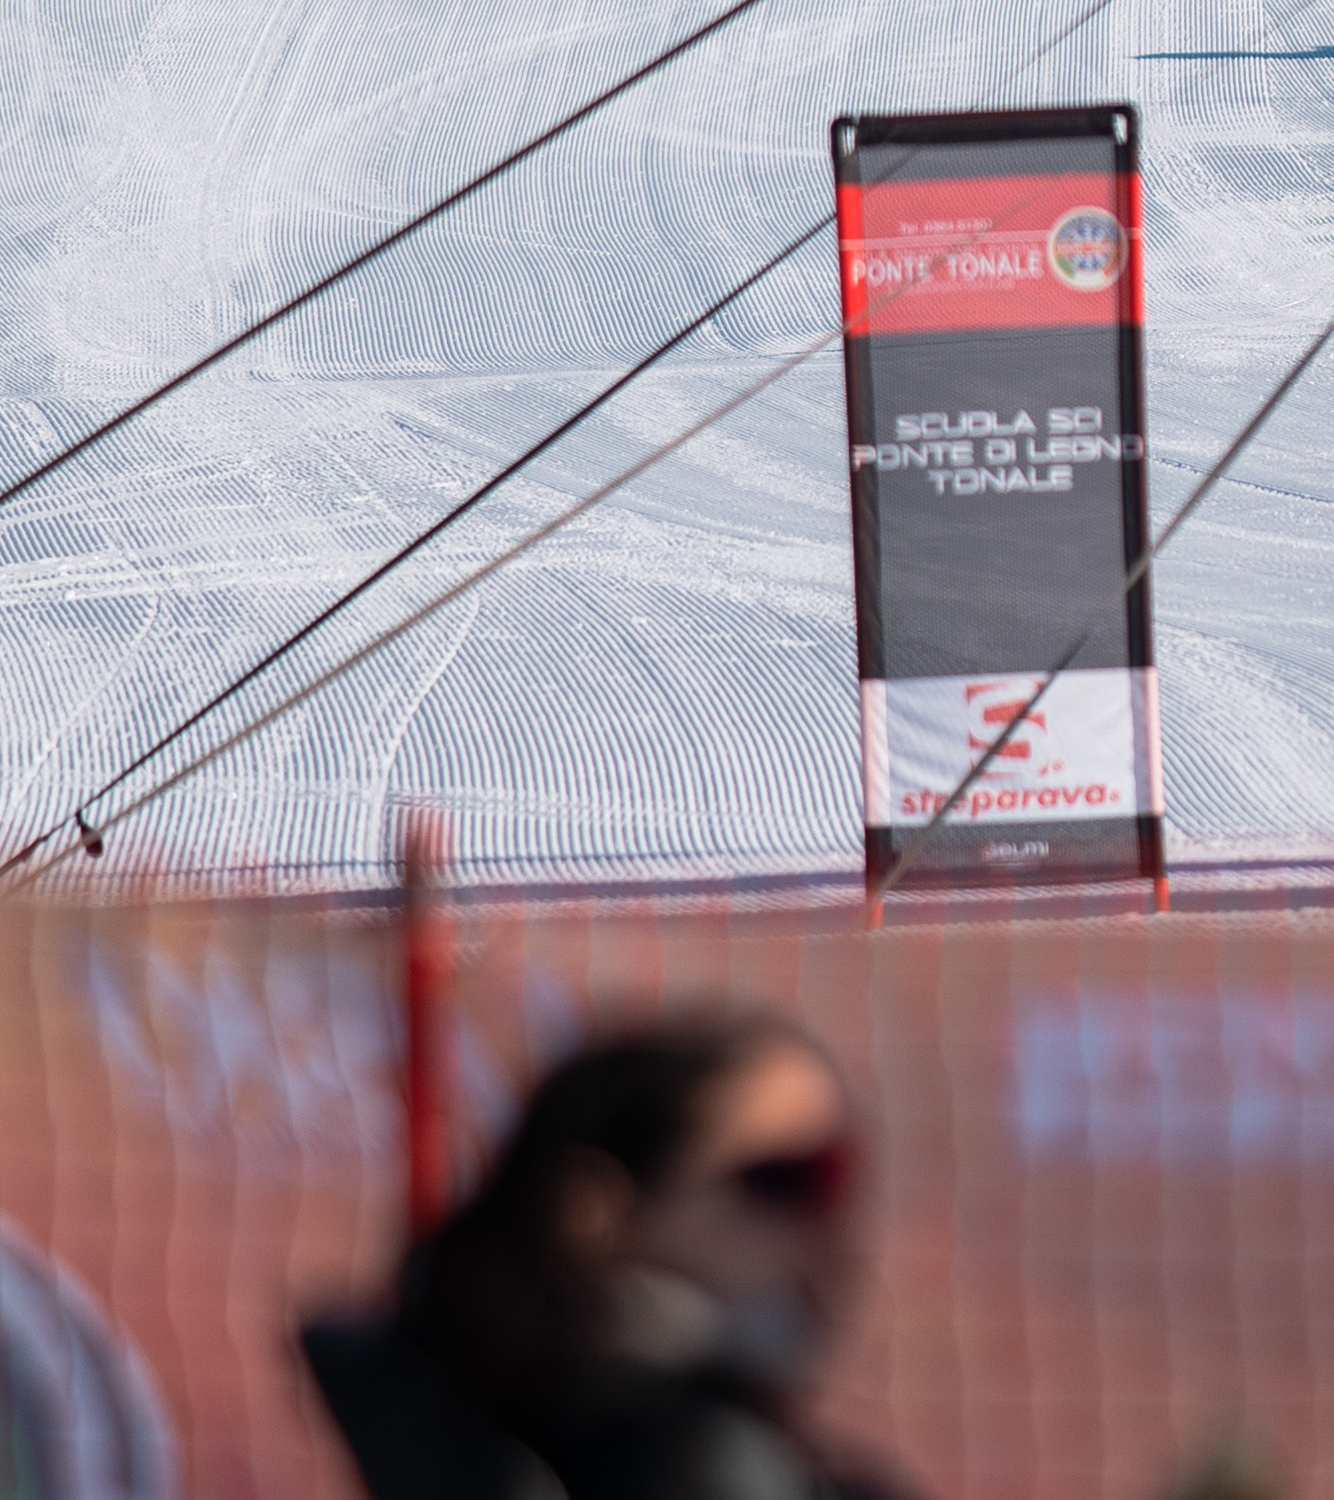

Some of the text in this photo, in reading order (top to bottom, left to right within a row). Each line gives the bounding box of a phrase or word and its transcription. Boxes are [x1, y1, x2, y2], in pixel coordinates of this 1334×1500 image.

[851, 255, 930, 288] PONTE
[945, 250, 1043, 280] TONALE
[896, 405, 1103, 441] SCUOLA SCI
[852, 433, 1145, 472] PONTE DI LEGNO
[927, 463, 1075, 496] TONALE
